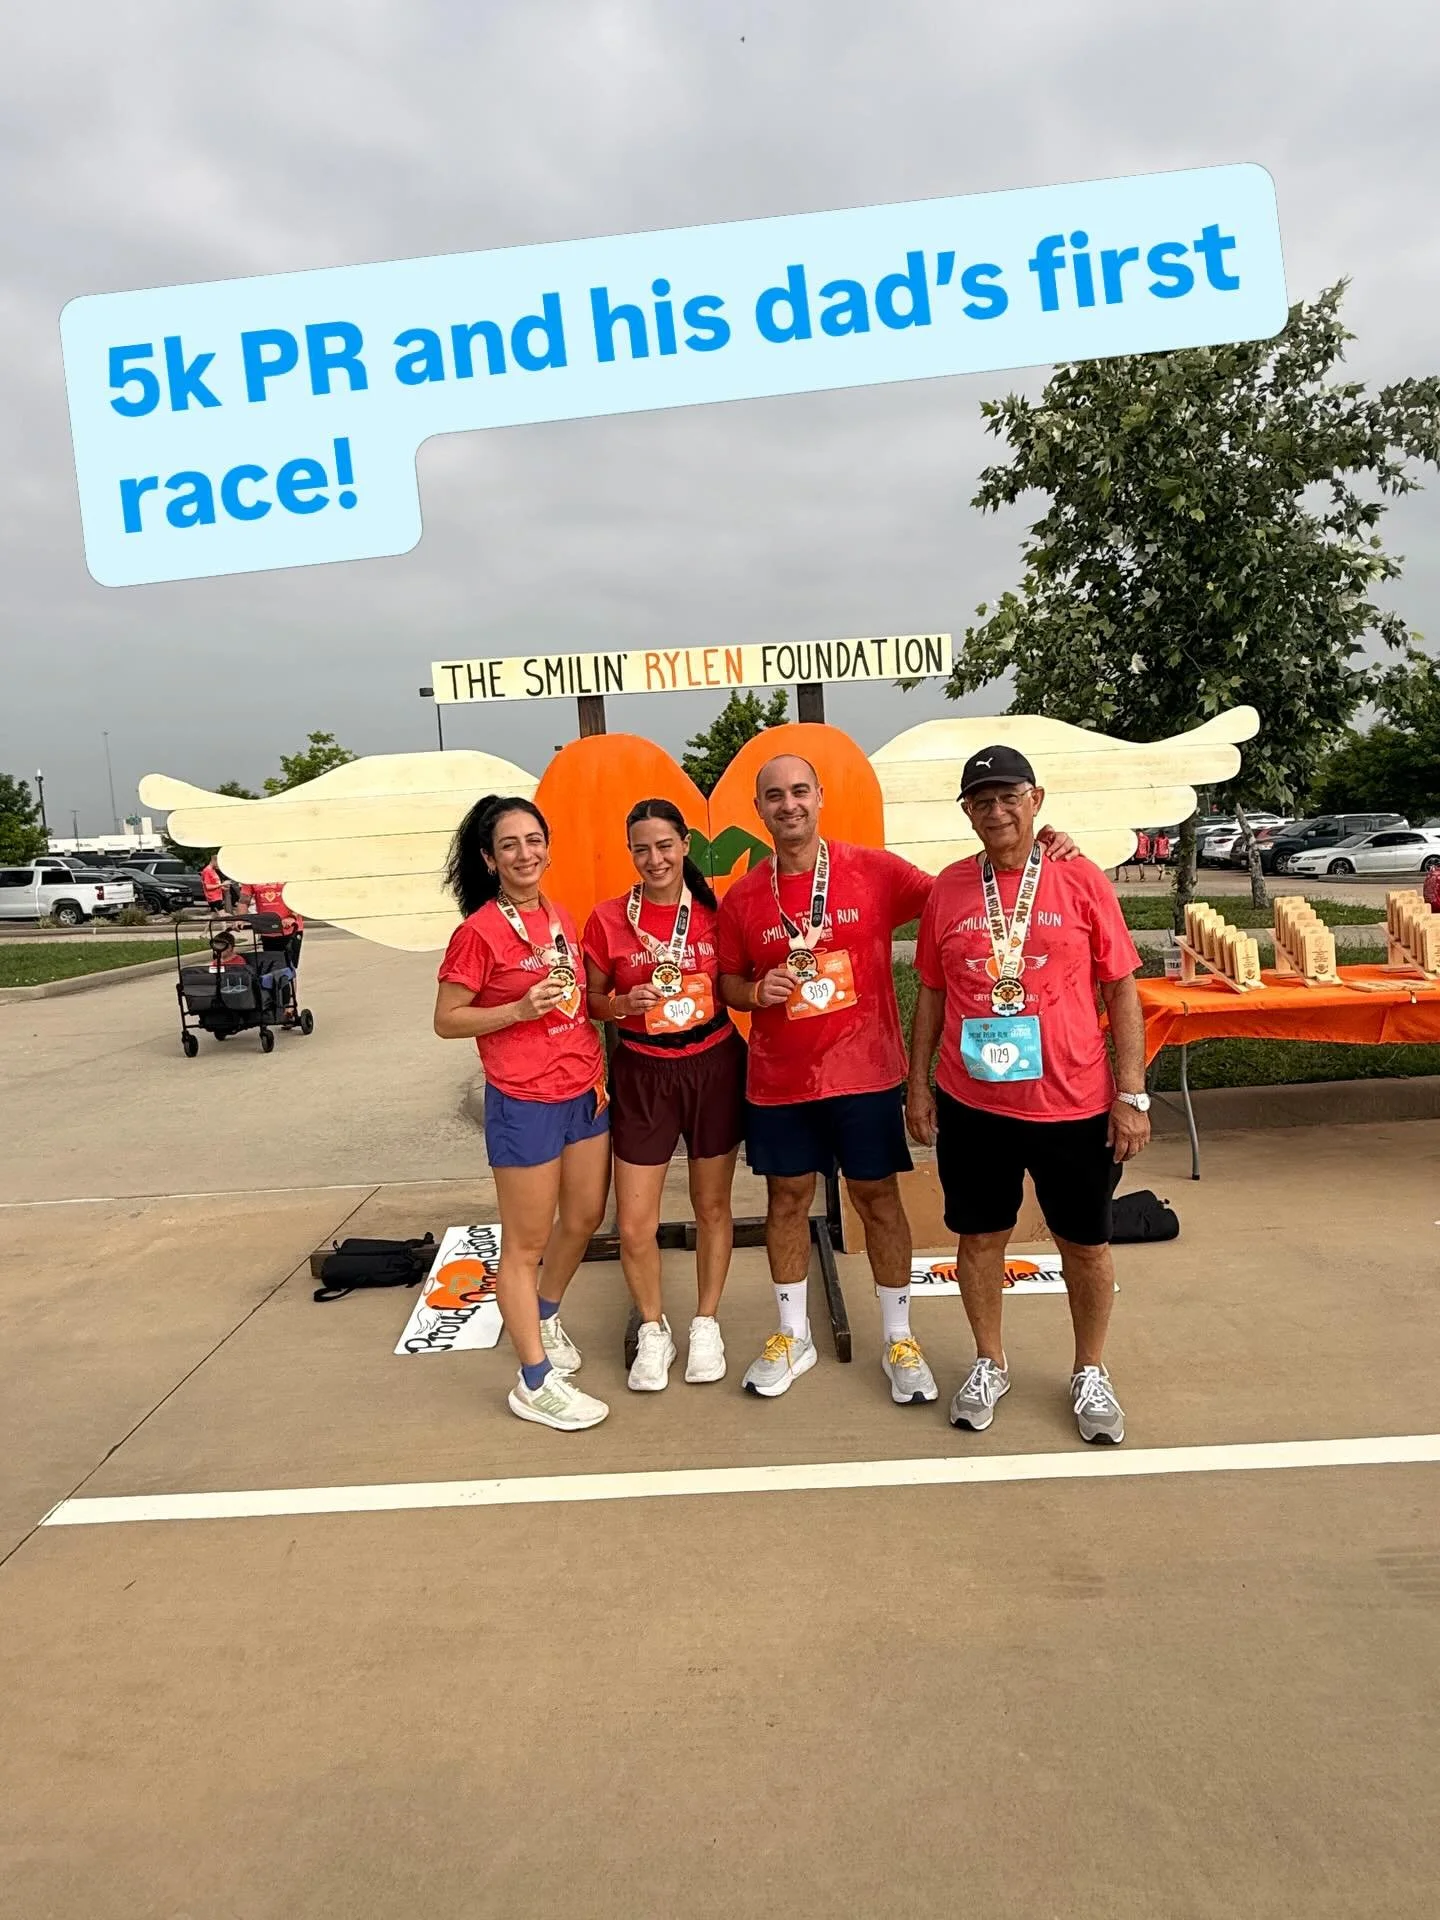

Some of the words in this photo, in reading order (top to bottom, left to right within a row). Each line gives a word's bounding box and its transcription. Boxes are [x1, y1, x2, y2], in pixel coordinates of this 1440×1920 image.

[441, 661, 506, 700] THE
[524, 653, 629, 697] SMILIN'
[645, 648, 744, 689] RYLEN
[762, 637, 943, 683] FOUNDATION
[837, 908, 859, 924] RUN
[1037, 911, 1062, 927] RUN
[807, 983, 829, 1001] 3139
[669, 1001, 690, 1018] 3140
[989, 1047, 1010, 1064] 1129
[404, 1305, 481, 1354] Proud
